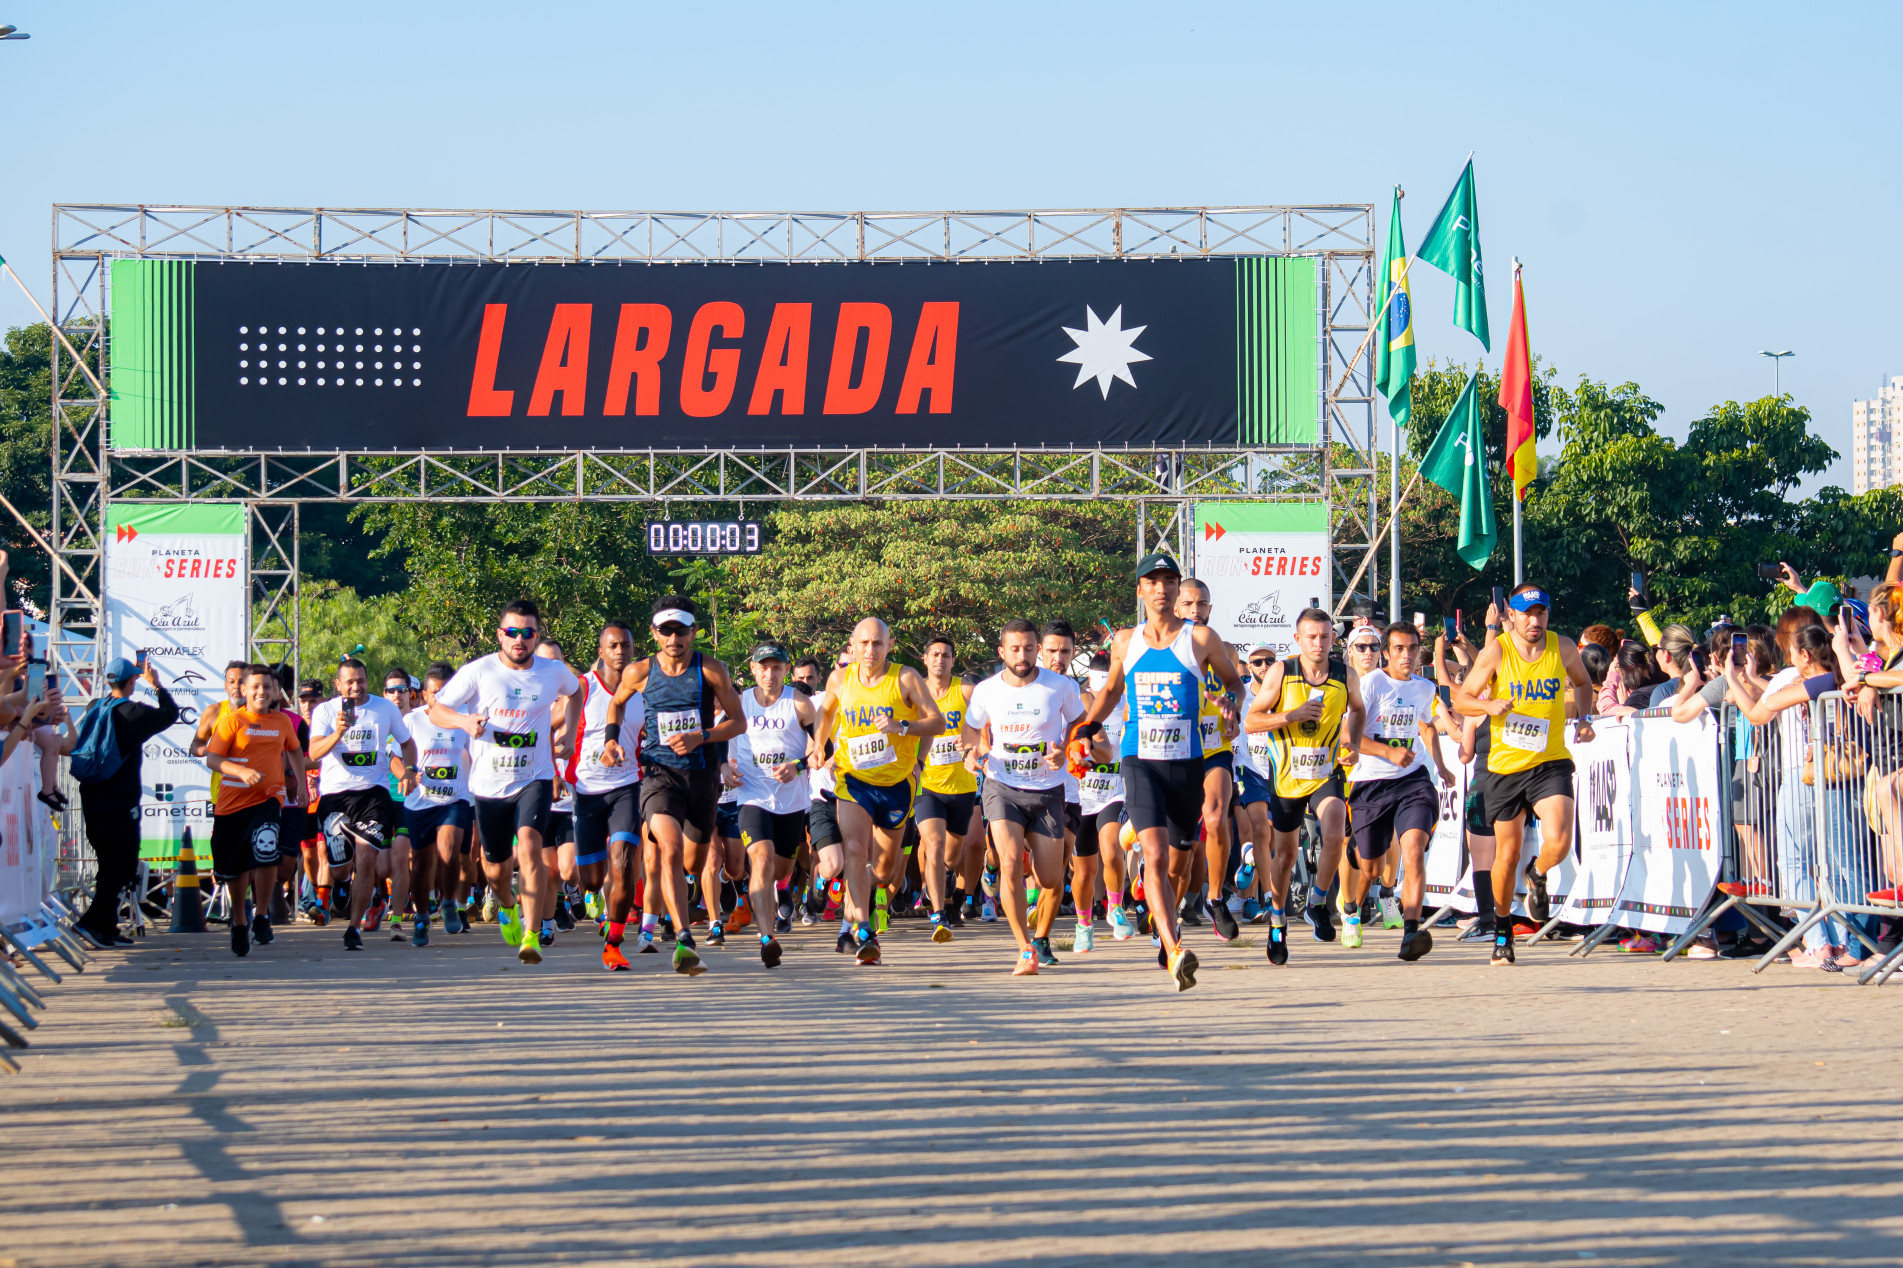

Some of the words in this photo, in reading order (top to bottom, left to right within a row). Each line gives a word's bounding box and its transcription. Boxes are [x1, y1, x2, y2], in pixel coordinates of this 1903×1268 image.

[467, 301, 960, 417] LARGADA
[650, 524, 759, 551] 00:00:03
[164, 558, 237, 579] SERIES
[1251, 555, 1322, 576] SERIES
[150, 616, 169, 627] Céu
[171, 616, 200, 627] Azul
[1238, 613, 1257, 624] Céu
[1258, 613, 1287, 624] Azul
[143, 646, 205, 656] PROMAFLEX
[1134, 671, 1182, 684] EQUIPE
[1525, 677, 1561, 701] AASP
[494, 707, 527, 718] ENERGY
[858, 705, 894, 727] AASP
[1390, 713, 1414, 726] 0839
[667, 717, 696, 732] 1282
[752, 714, 786, 731] 1900
[1000, 723, 1031, 733] ENERGY
[1510, 721, 1541, 738] 1185
[349, 729, 372, 740] 0878
[1149, 728, 1181, 744] 0778
[858, 738, 885, 757] 1180
[1253, 745, 1268, 756] 077
[499, 754, 528, 768] 1116
[759, 752, 786, 765] 0629
[1011, 757, 1038, 771] 0546
[1300, 753, 1326, 767] 0578
[1086, 778, 1110, 791] 1031
[1656, 772, 1685, 788] PLANETA
[431, 786, 454, 797] 1190
[1665, 796, 1711, 851] SERIES
